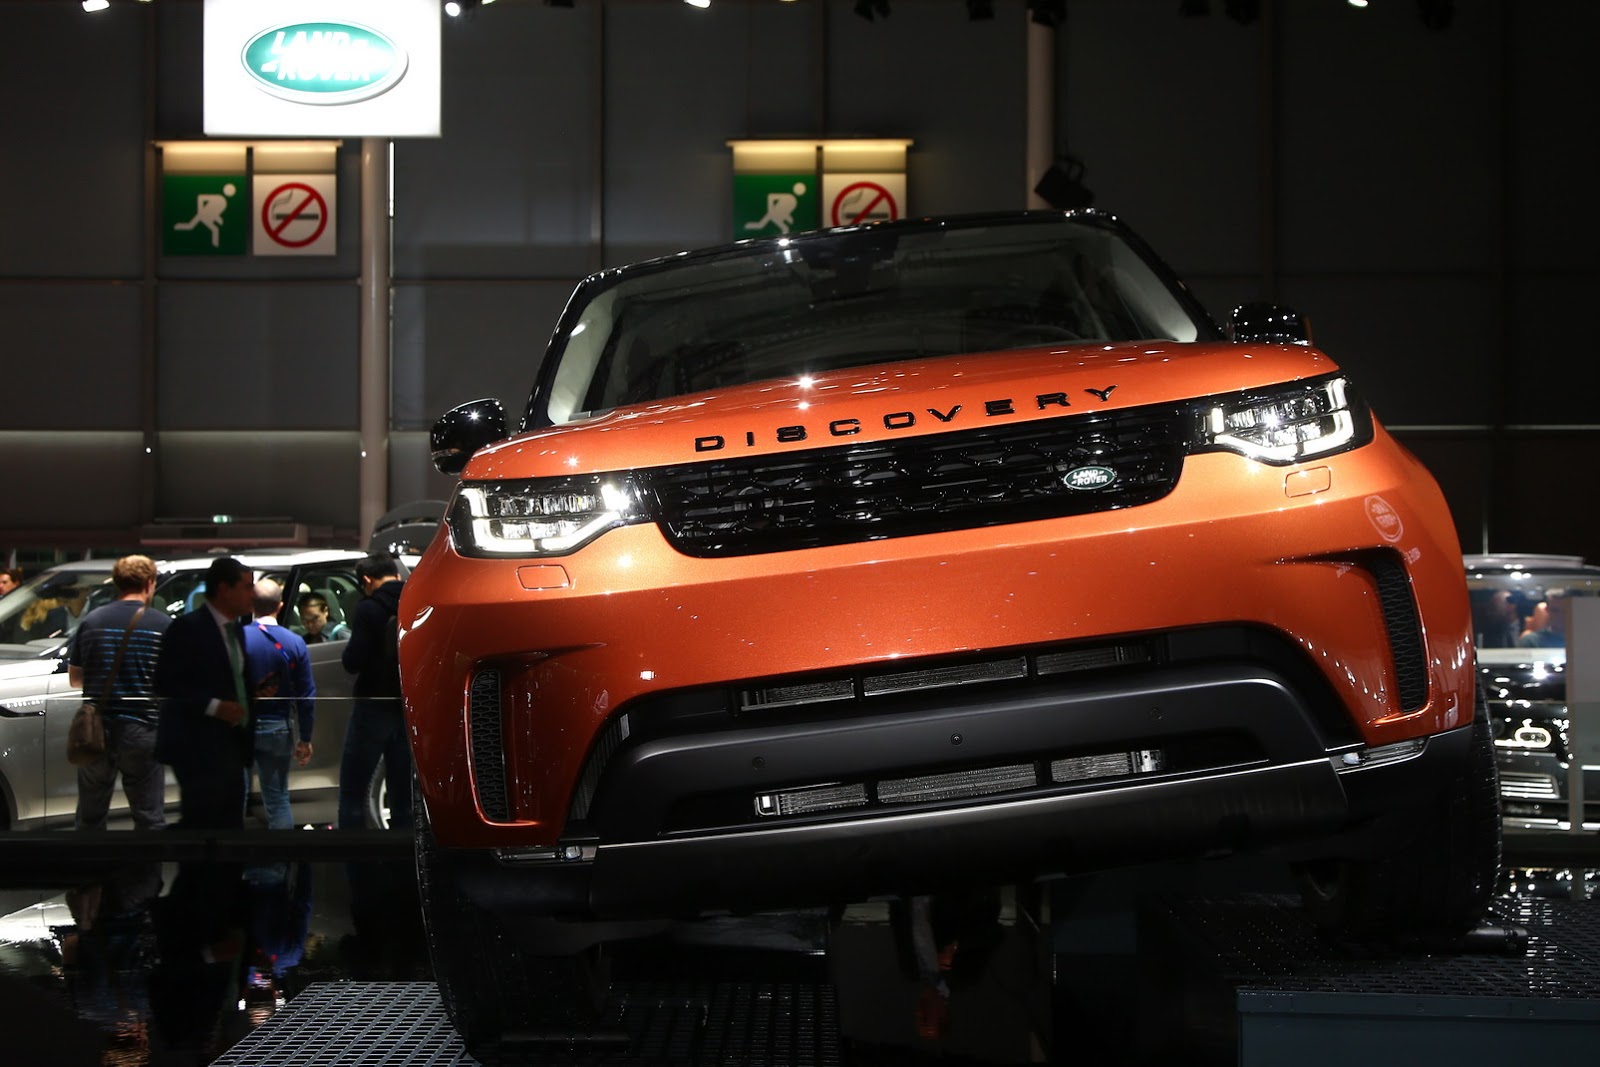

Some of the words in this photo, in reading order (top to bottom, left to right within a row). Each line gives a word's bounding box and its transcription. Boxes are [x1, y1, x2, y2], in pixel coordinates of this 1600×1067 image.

[271, 31, 351, 55] LAND
[695, 384, 1118, 452] DISCOVERY
[1073, 469, 1098, 479] LAND
[1077, 475, 1108, 486] ROVER
